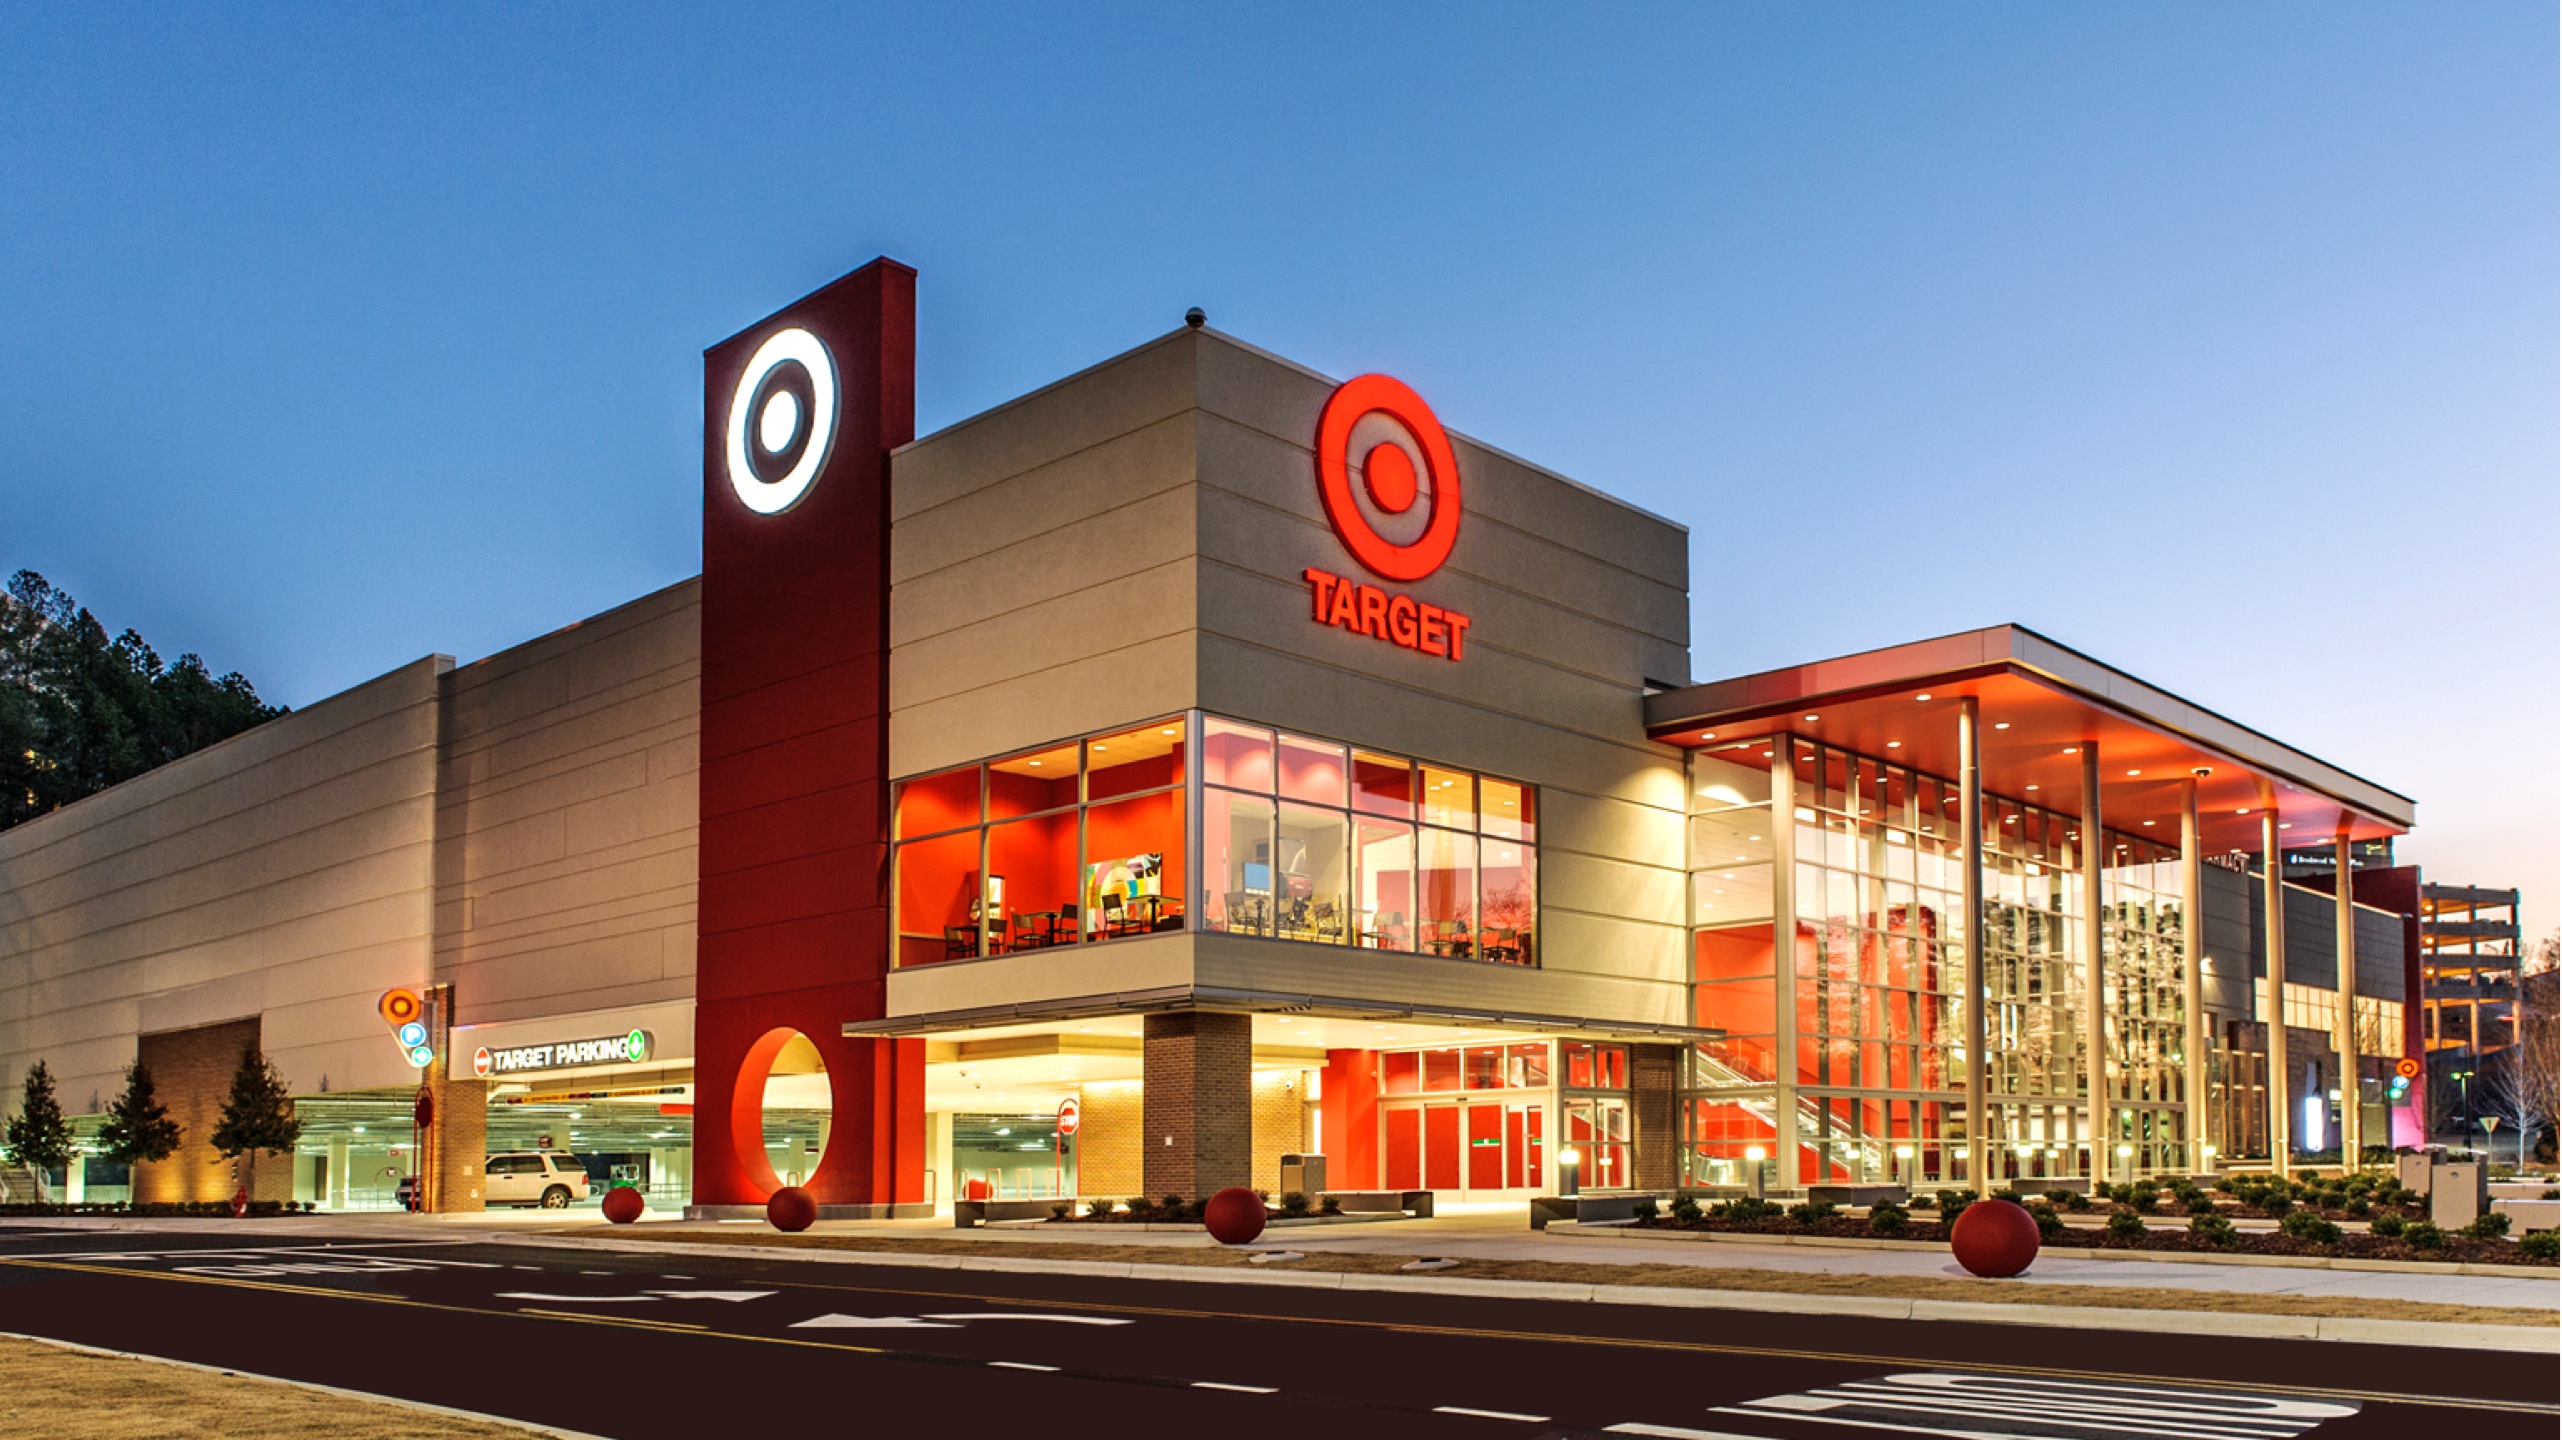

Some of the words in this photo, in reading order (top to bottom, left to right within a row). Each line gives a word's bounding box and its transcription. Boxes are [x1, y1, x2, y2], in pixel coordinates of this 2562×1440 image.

[1303, 567, 1470, 661] TARGET
[494, 1046, 555, 1071] TARGET
[556, 1037, 630, 1065] PARKING
